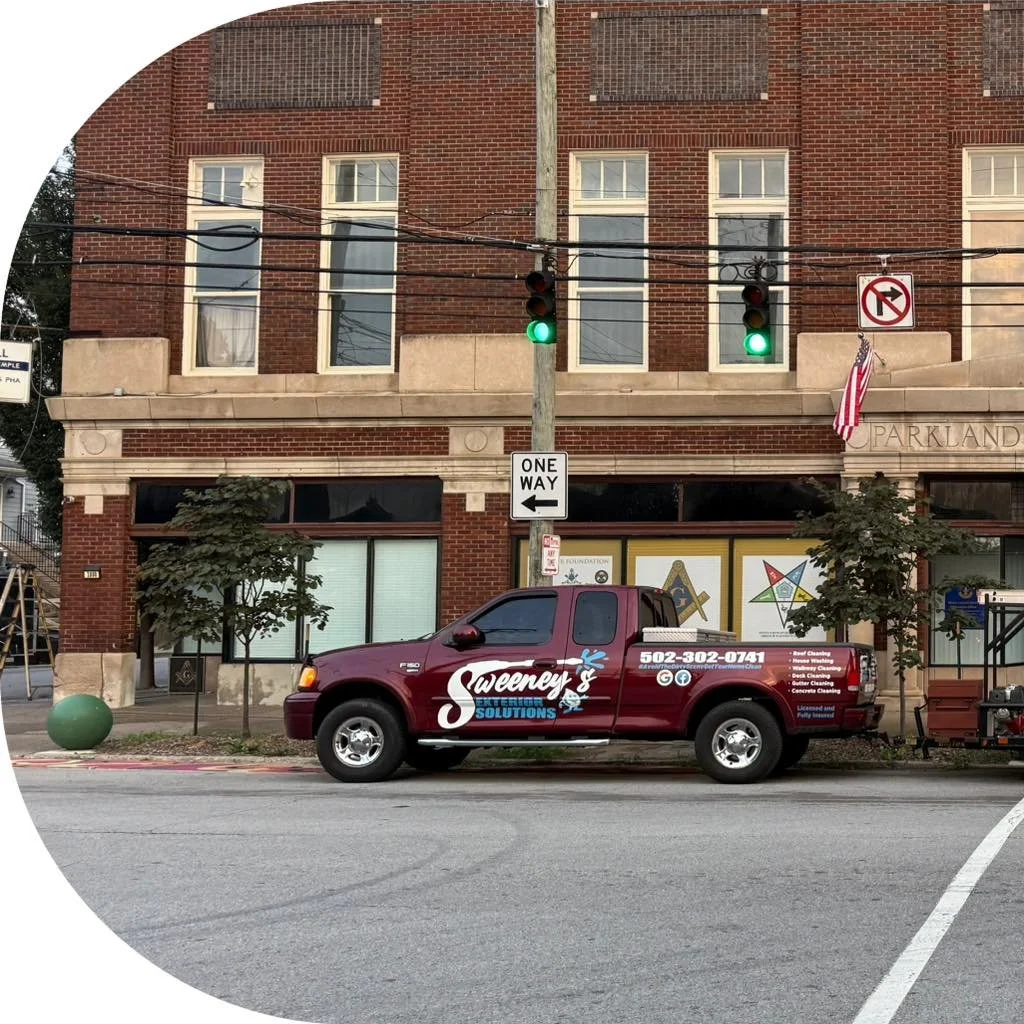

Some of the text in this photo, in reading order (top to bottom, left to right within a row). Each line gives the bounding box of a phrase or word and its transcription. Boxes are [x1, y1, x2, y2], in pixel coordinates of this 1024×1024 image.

[872, 422, 1022, 450] PARKLAND
[521, 458, 558, 473] ONE
[520, 476, 559, 490] WAY
[640, 651, 765, 663] 502-302-0741
[437, 660, 597, 729] Sweeney's
[475, 696, 543, 707] EXTERIOR
[475, 707, 557, 720] SOLUTIONS
